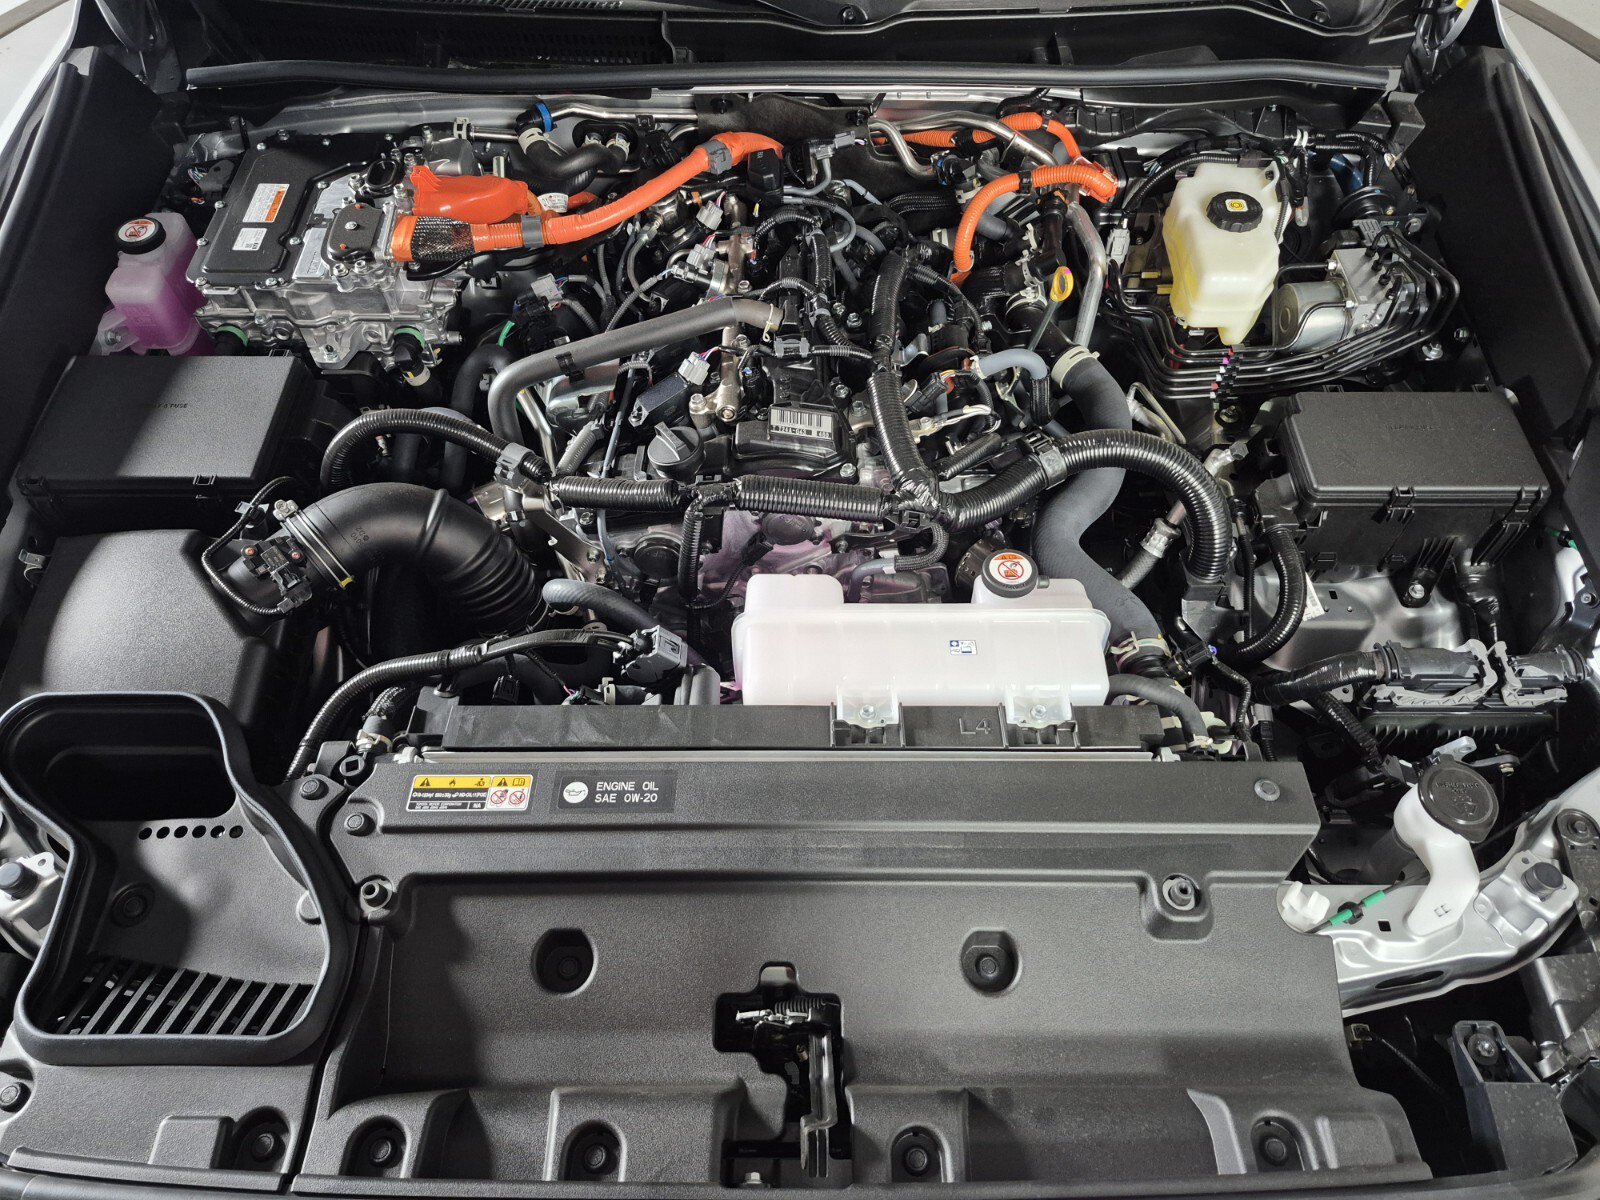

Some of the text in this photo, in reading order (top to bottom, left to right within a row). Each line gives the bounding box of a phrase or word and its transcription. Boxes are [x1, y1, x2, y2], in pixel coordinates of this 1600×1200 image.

[958, 717, 991, 735] L4
[596, 781, 659, 791] ENGINE OIL
[594, 793, 658, 803] SAE 0W-20
